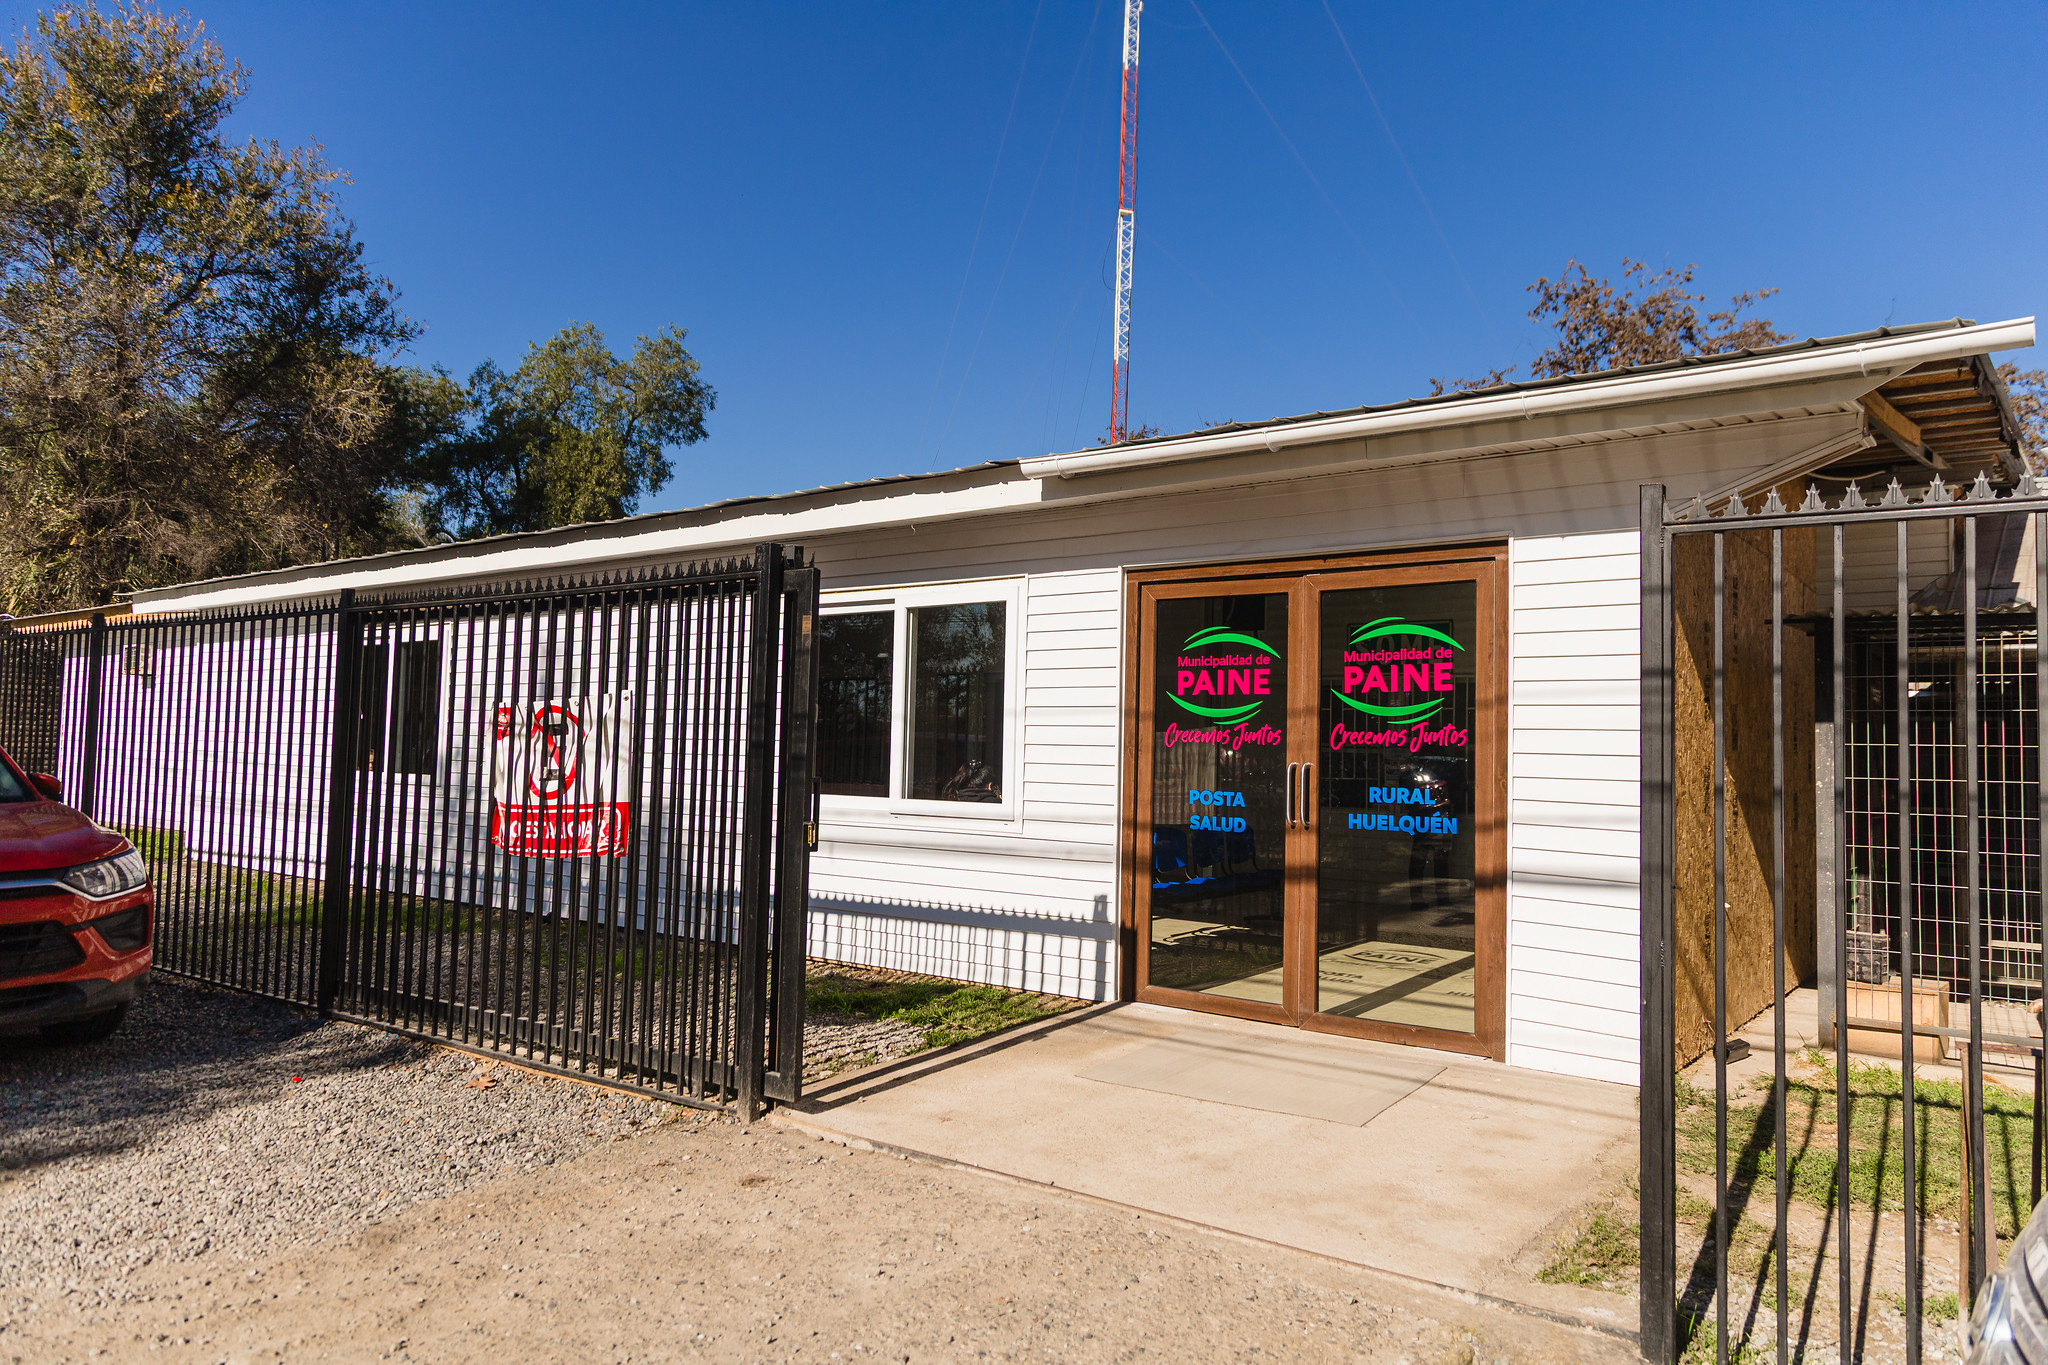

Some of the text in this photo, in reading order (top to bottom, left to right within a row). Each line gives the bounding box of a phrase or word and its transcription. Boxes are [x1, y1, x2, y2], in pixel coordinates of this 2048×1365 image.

[1177, 653, 1271, 668] Municipalidad de
[1343, 647, 1453, 663] Municipalidad de
[1177, 668, 1271, 696] PAINE
[1343, 661, 1453, 693] PAINE
[1164, 722, 1282, 751] Crecemos Juntos
[1330, 722, 1469, 753] Crecemos Juntos
[1189, 789, 1246, 808] POSTA
[1369, 787, 1436, 805] RURAL
[1190, 814, 1247, 833] SALUD
[1349, 812, 1458, 836] HUELQUÉN
